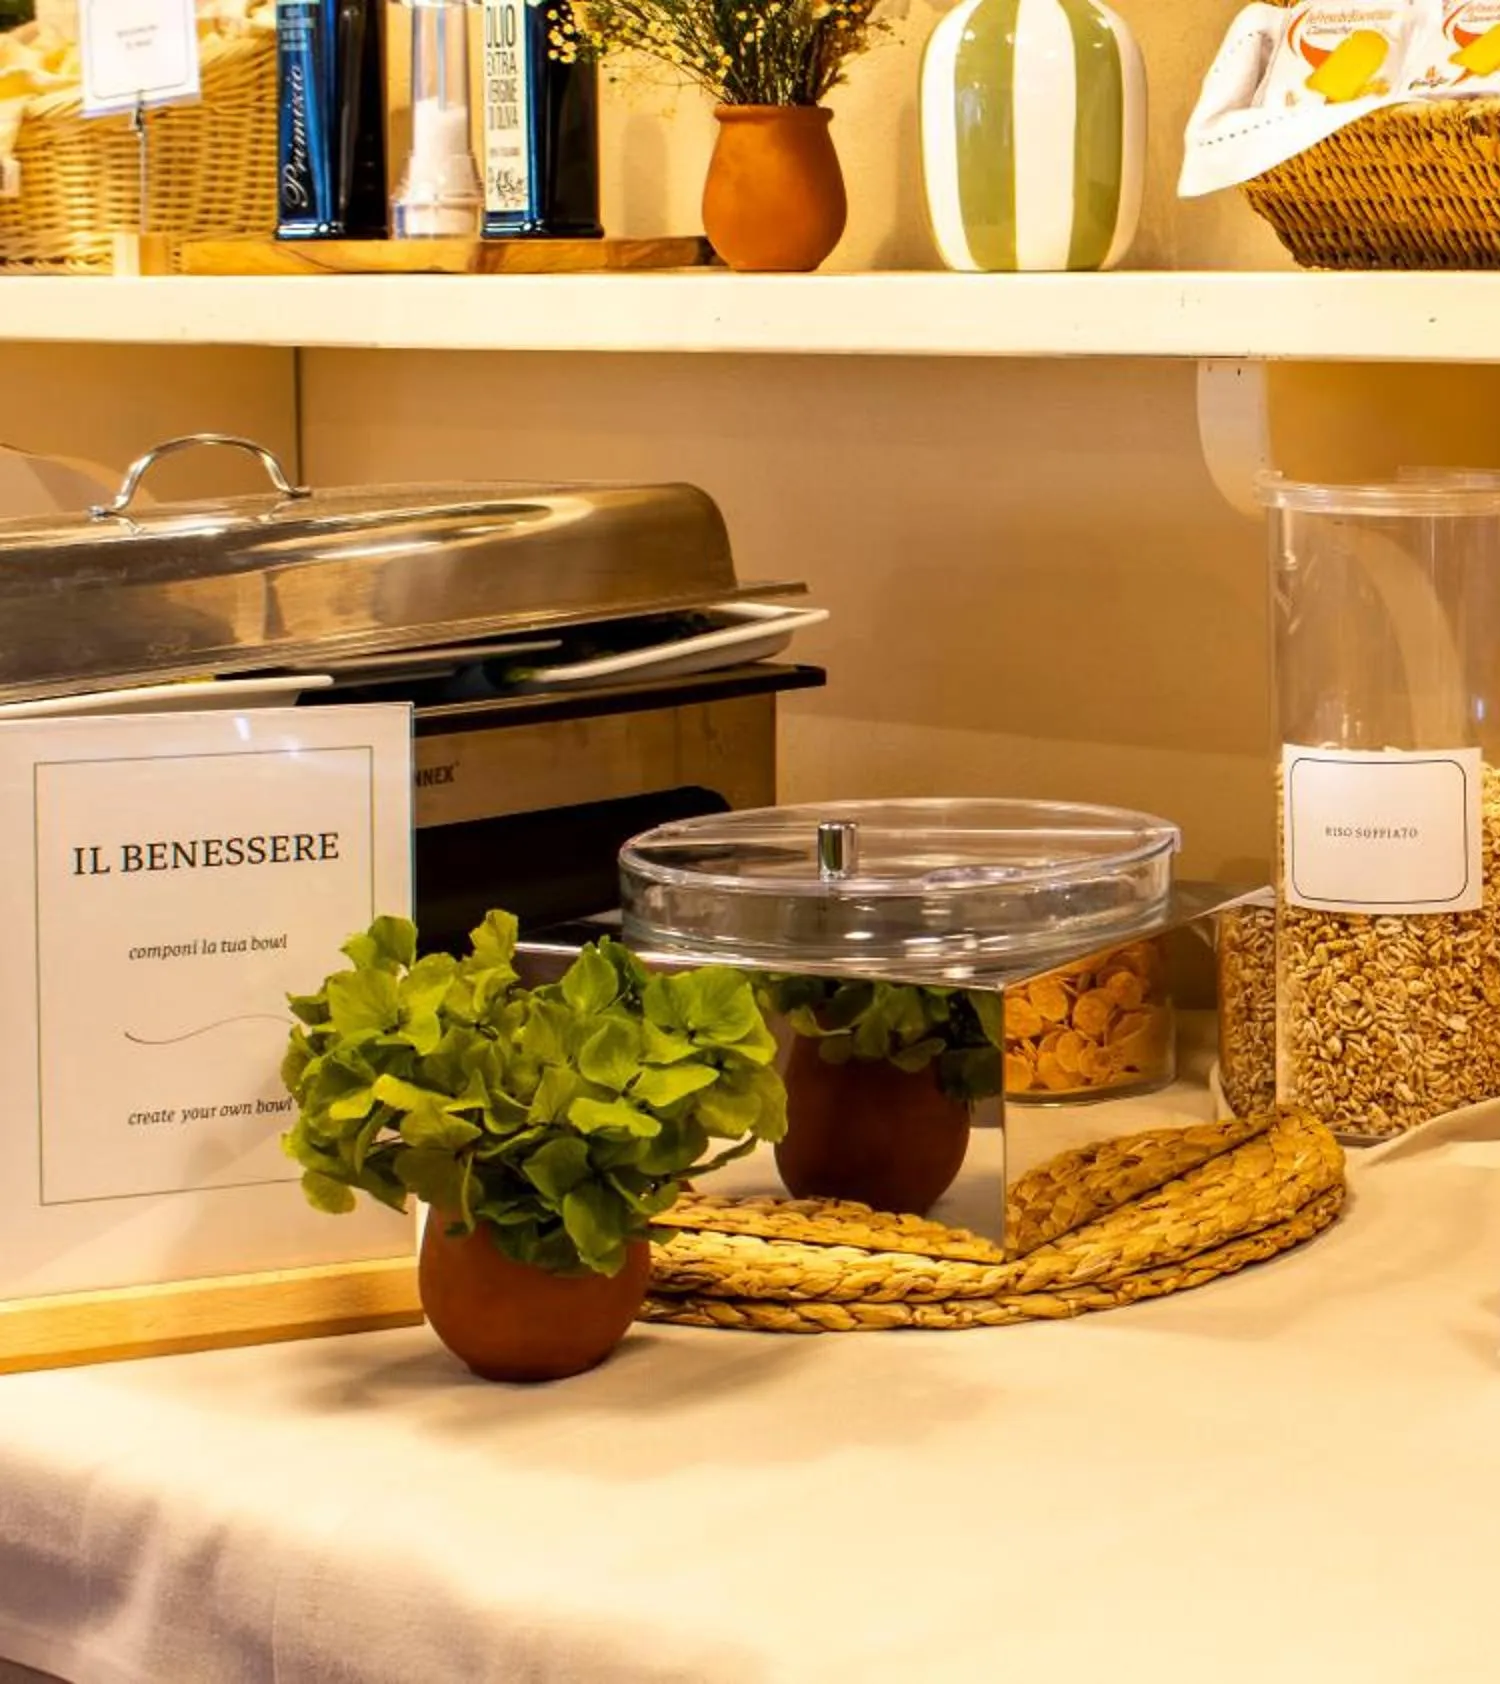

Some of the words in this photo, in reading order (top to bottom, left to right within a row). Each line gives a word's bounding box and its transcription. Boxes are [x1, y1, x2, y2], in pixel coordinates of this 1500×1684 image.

[1325, 826, 1353, 837] RISO
[1355, 827, 1419, 839] SOFFIATO
[73, 846, 111, 875] IL
[120, 832, 340, 873] BENESSERE
[128, 939, 198, 960] componi
[201, 938, 217, 955] la
[220, 937, 248, 954] tua
[250, 933, 288, 951] bowl
[128, 1109, 175, 1125] create
[180, 1106, 217, 1123] your
[219, 1103, 252, 1117] own
[255, 1096, 293, 1115] bowl
